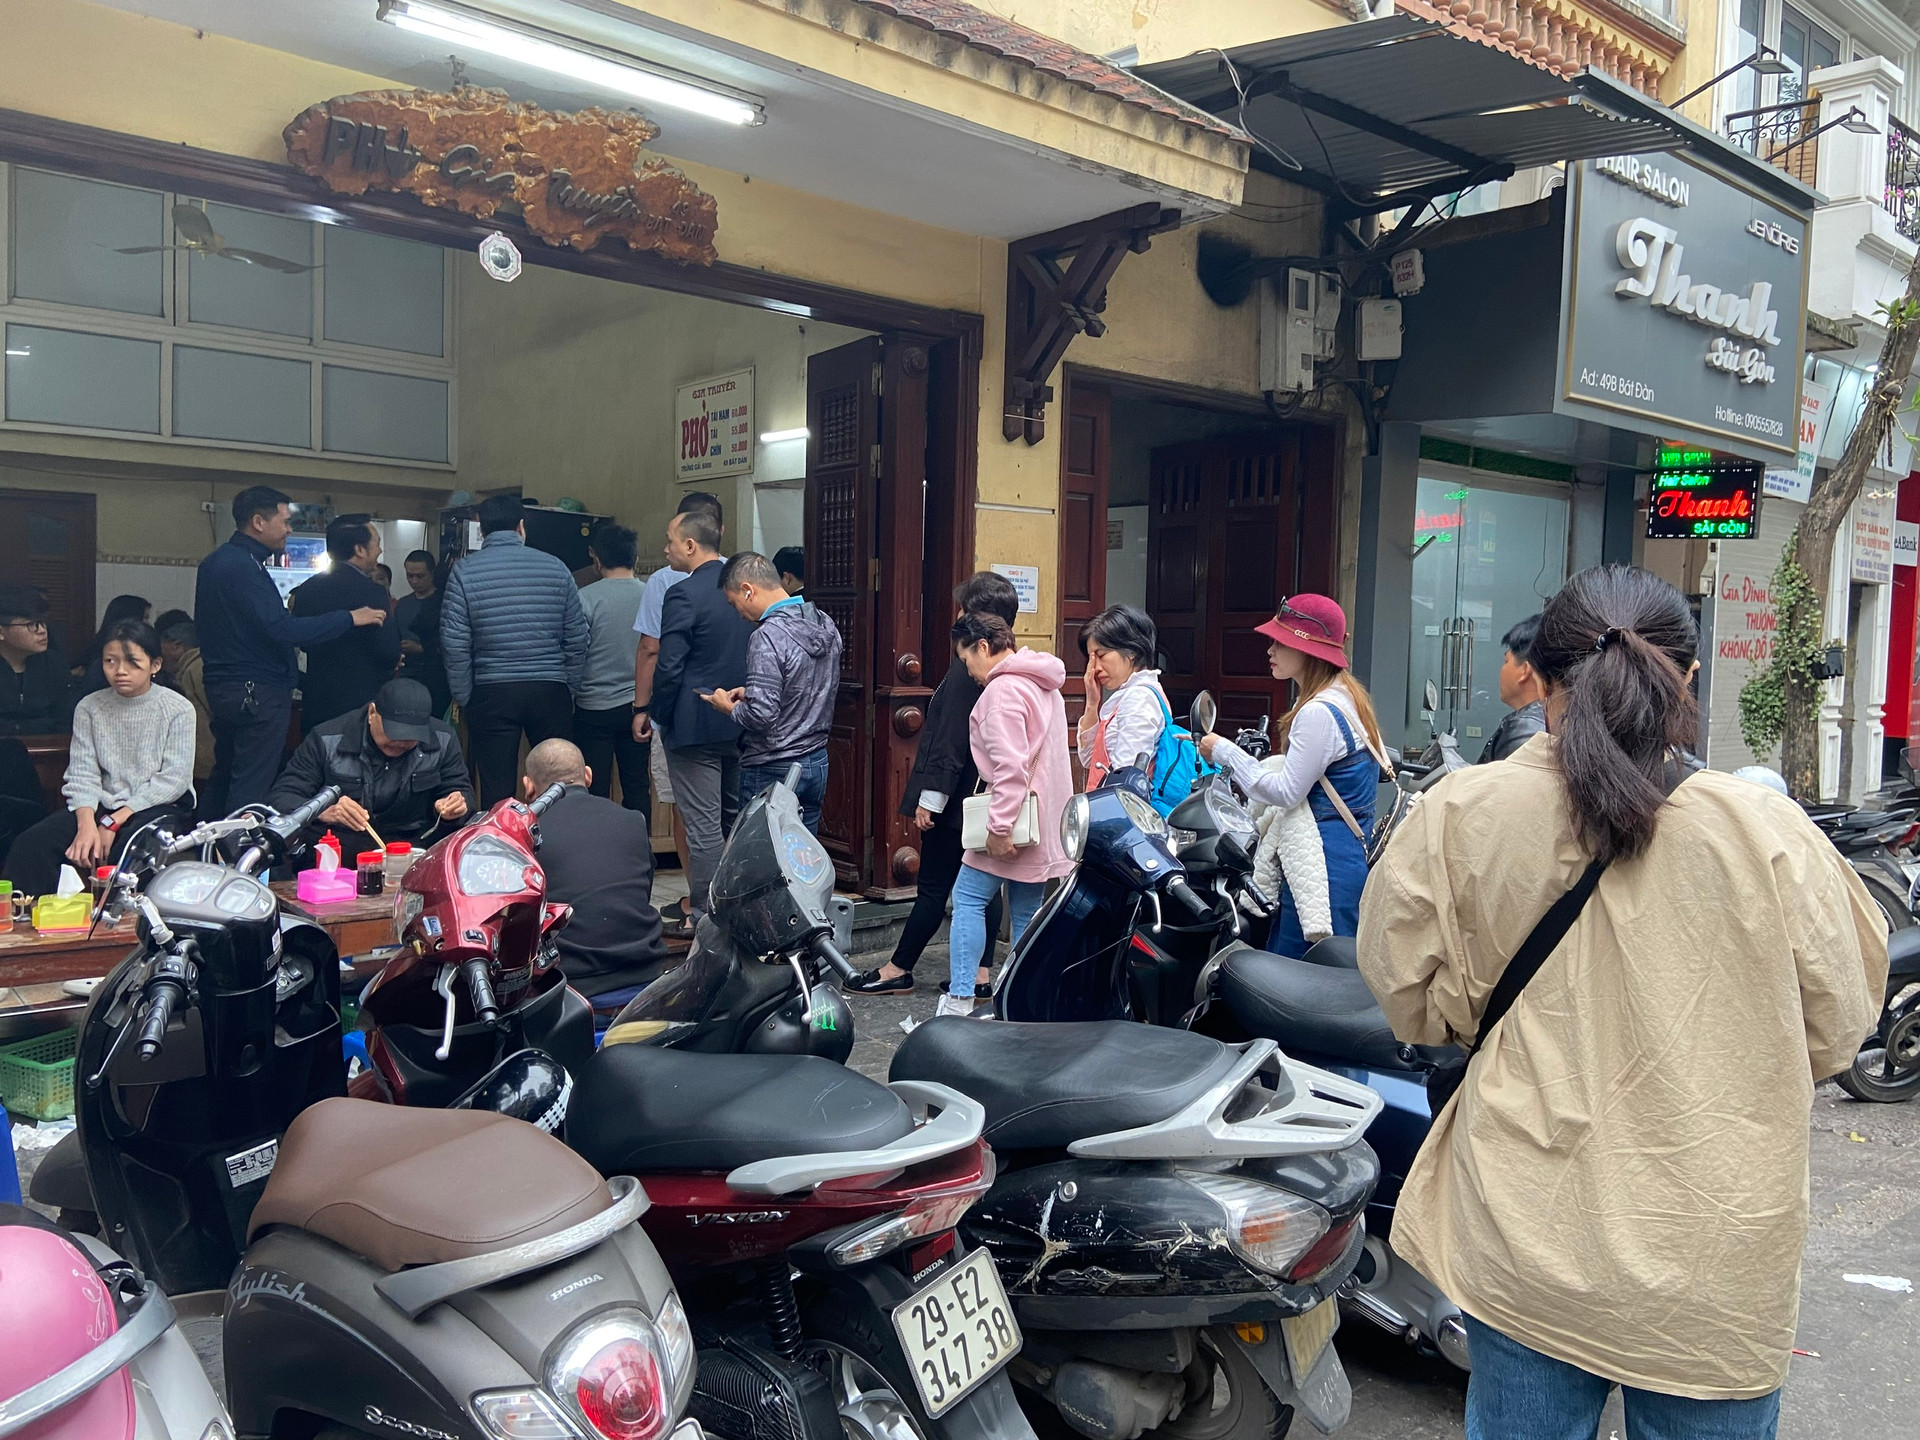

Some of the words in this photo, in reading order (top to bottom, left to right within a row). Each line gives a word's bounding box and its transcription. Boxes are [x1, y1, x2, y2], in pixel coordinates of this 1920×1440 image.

[1642, 164, 1690, 207] SALON
[1615, 217, 1781, 347] Thanh
[1707, 337, 1740, 372] Sài
[1740, 348, 1776, 384] Gòn
[1580, 367, 1599, 388] Ad:
[1600, 373, 1617, 391] 49B
[1618, 377, 1635, 397] Bát
[1635, 382, 1655, 402] Đàn
[1657, 490, 1751, 518] Thanh
[1694, 519, 1714, 534] SÀI
[1718, 519, 1746, 534] GÒN
[685, 1210, 791, 1228] VISION
[550, 1274, 604, 1302] HONDA
[912, 1258, 945, 1284] HONDA
[911, 1266, 989, 1351] 29-E2
[921, 1306, 1013, 1404] 347.38
